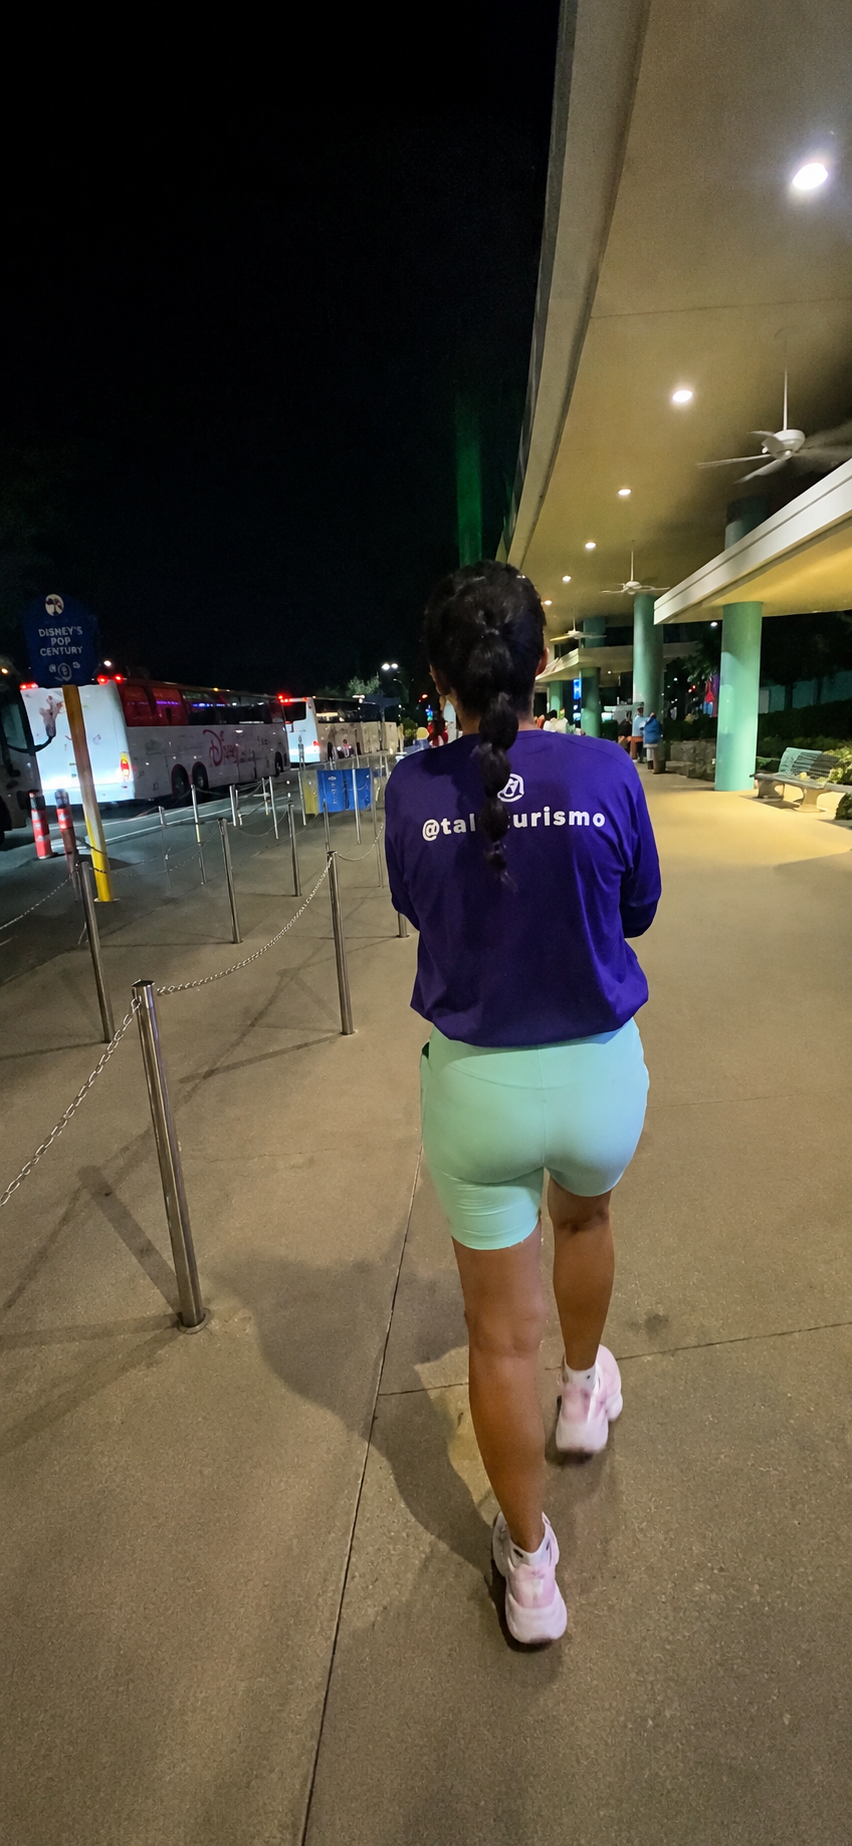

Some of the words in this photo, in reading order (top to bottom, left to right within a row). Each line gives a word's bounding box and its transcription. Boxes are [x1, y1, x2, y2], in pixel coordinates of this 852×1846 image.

[38, 626, 83, 637] DISNEY'S
[50, 637, 71, 646] POP
[40, 646, 83, 657] CENTURY
[422, 806, 606, 842] @talurismo
